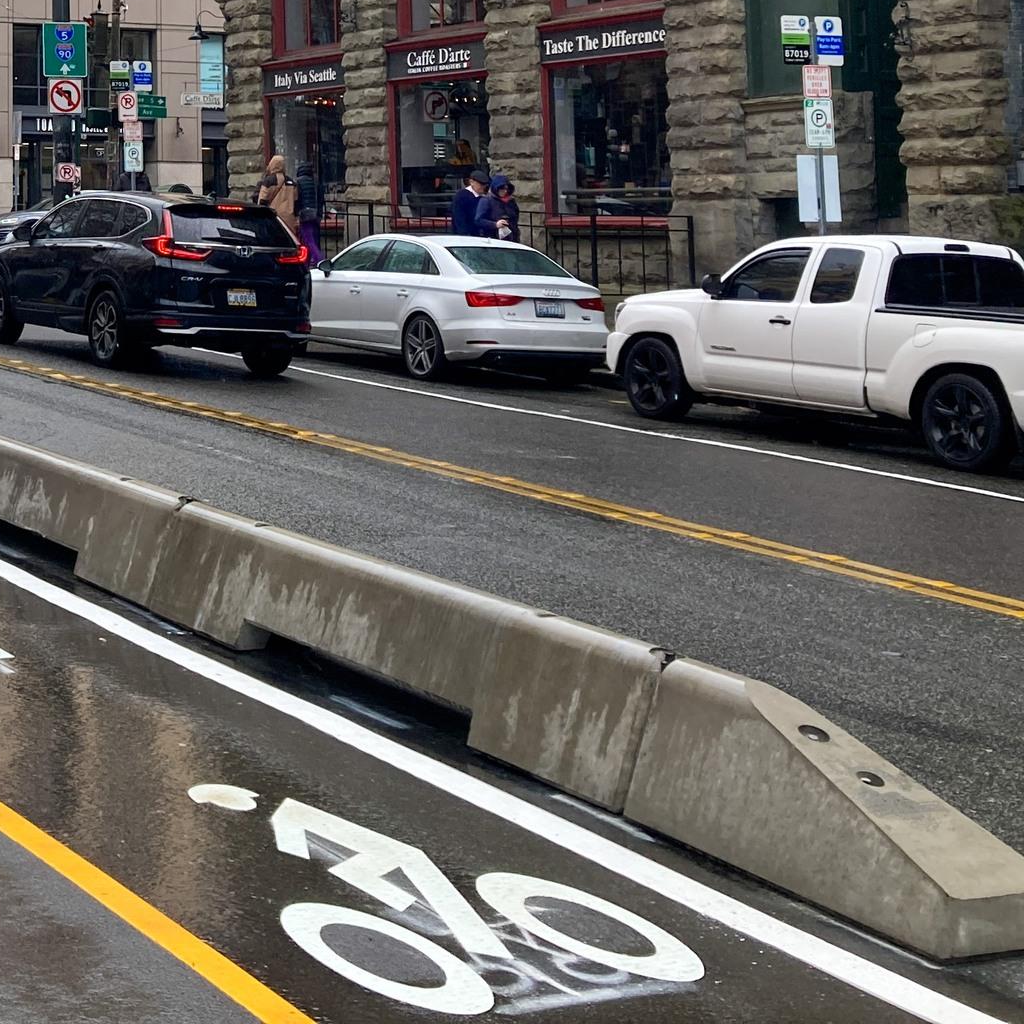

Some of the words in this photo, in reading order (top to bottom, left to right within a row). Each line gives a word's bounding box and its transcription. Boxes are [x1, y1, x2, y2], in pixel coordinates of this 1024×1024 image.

[61, 31, 68, 41] 5
[543, 38, 574, 56] Taste
[575, 35, 599, 52] The
[601, 29, 666, 49] Difference
[58, 50, 72, 59] 90
[407, 50, 436, 68] Caffé
[438, 47, 471, 64] D'arte
[274, 73, 292, 89] Italy
[294, 71, 308, 85] Via
[309, 67, 337, 83] Seattle
